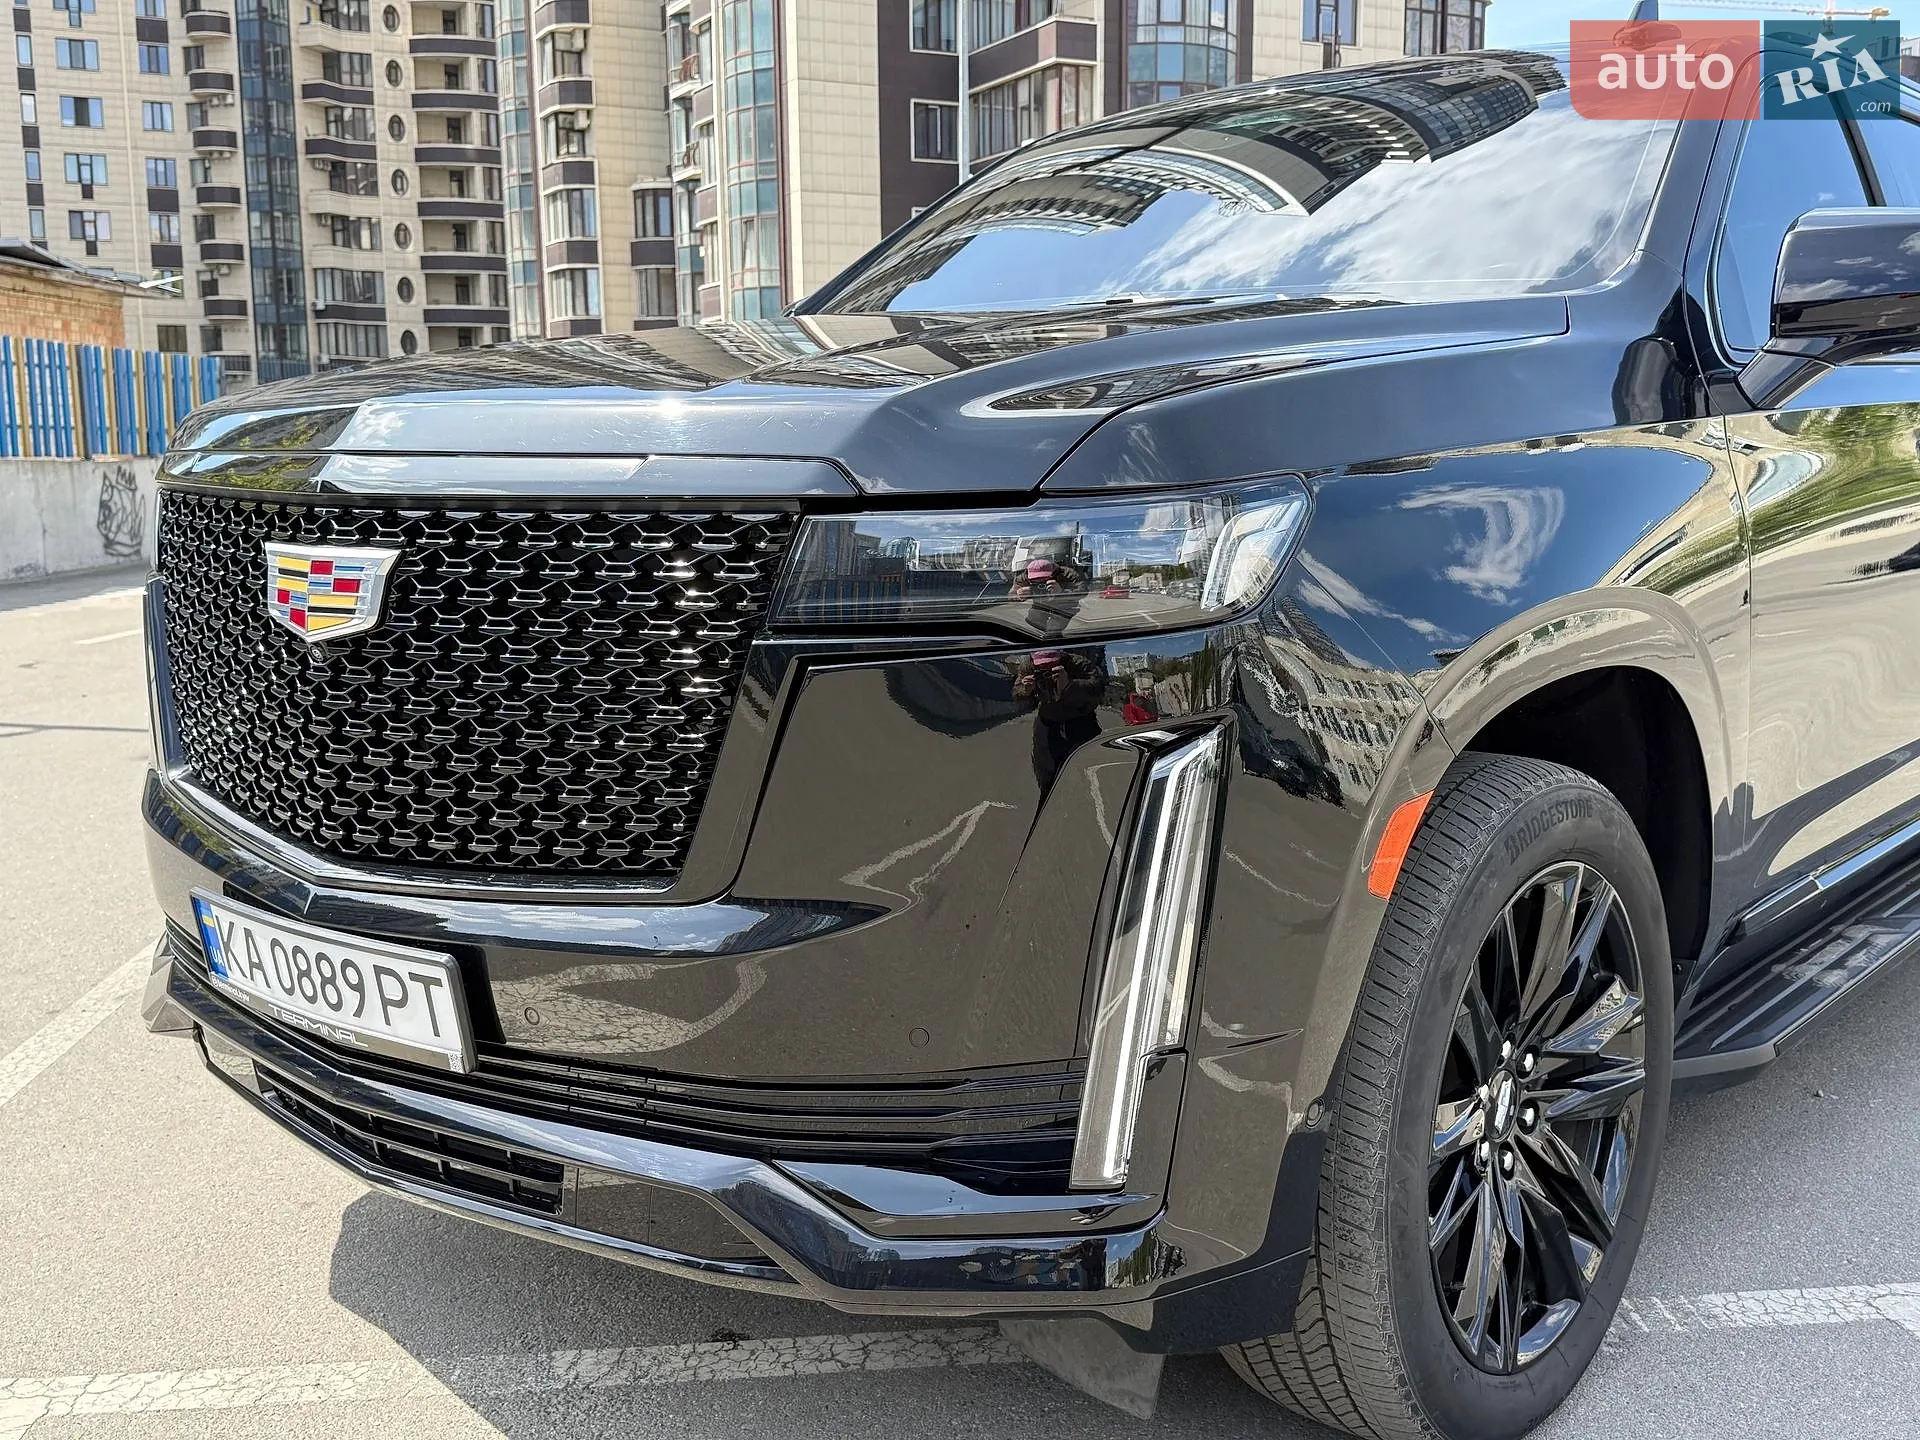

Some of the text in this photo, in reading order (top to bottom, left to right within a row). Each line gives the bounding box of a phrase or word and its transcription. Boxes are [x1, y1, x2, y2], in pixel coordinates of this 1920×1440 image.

[1504, 797, 1594, 865] BRIDGESTONE
[209, 946, 225, 967] UA
[268, 1003, 369, 1048] TERMINAL
